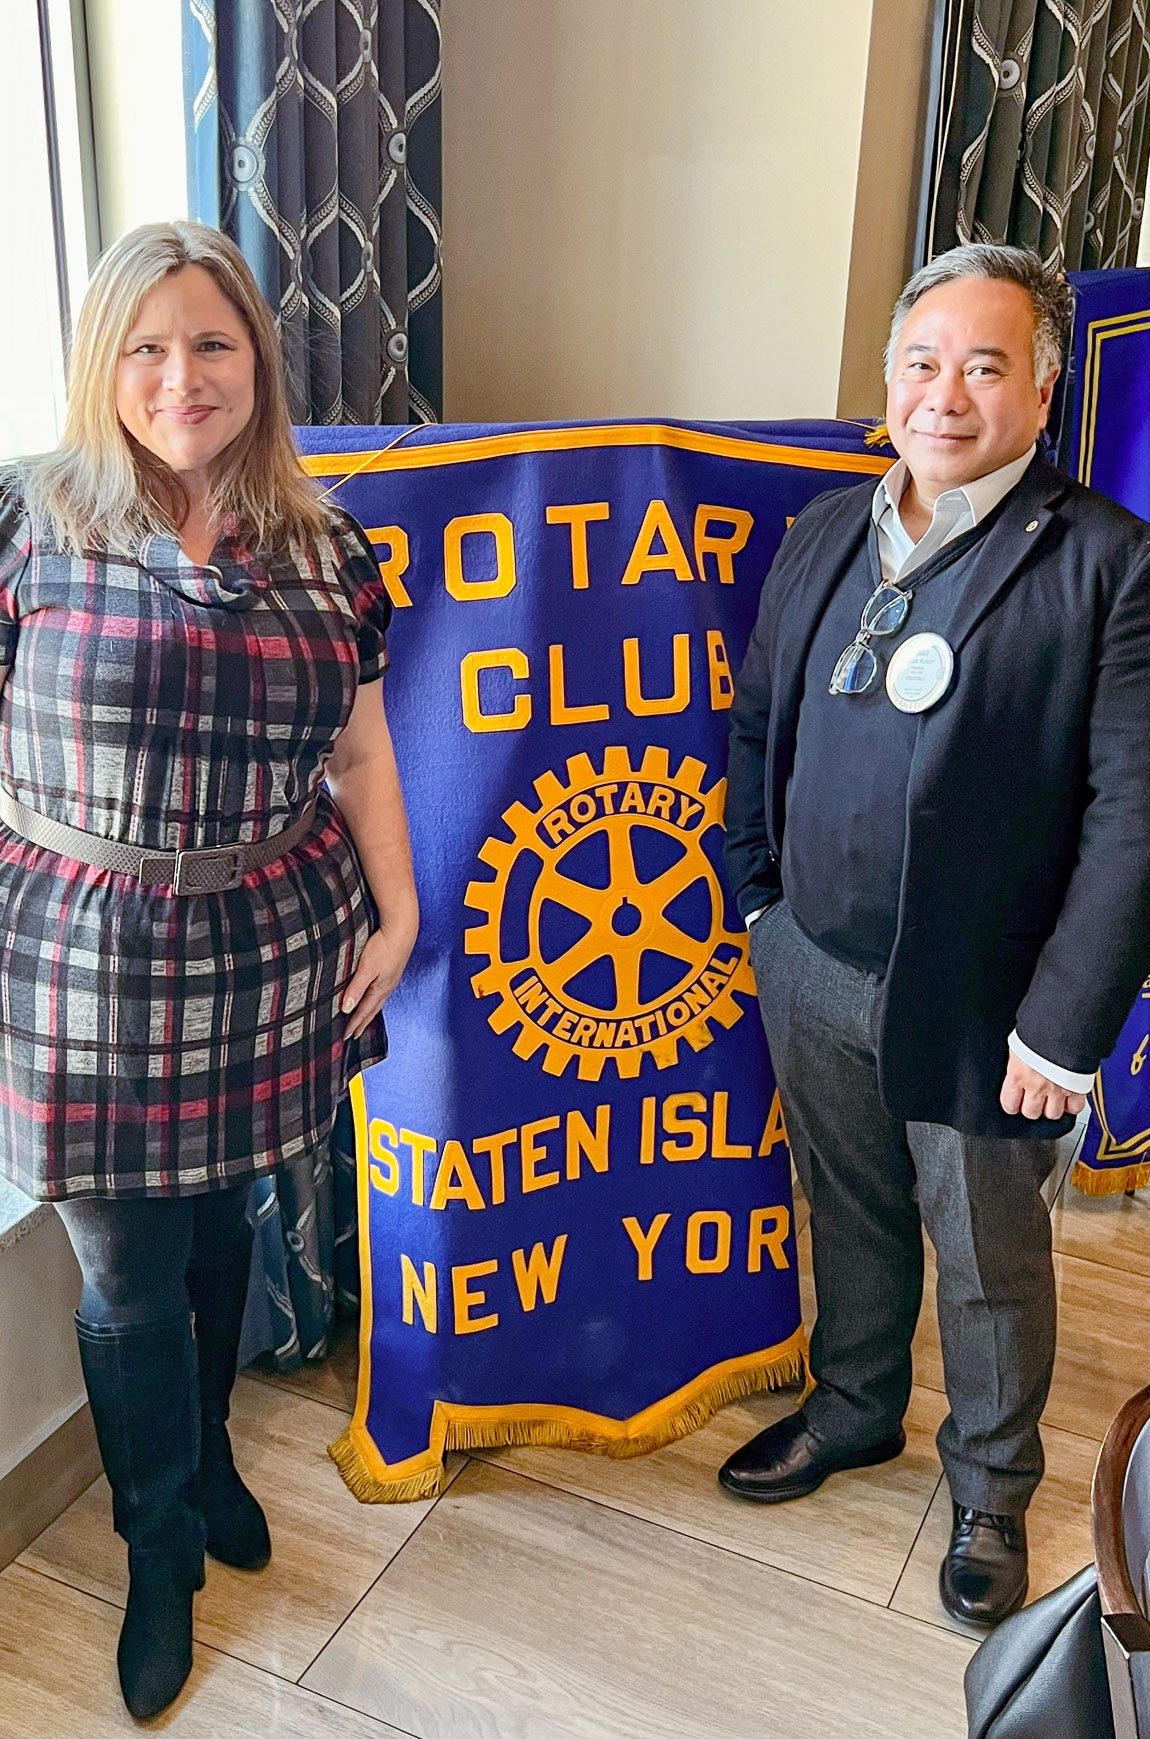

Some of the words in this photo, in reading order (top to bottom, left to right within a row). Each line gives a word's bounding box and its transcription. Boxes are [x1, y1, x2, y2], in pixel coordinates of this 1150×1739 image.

[363, 499, 796, 607] ROTAR
[460, 630, 735, 733] CLUB
[542, 782, 702, 845] ROTARY
[513, 956, 739, 1047] INTERNATIONAL
[368, 1104, 611, 1210] STATEN
[400, 1234, 568, 1335] NEW
